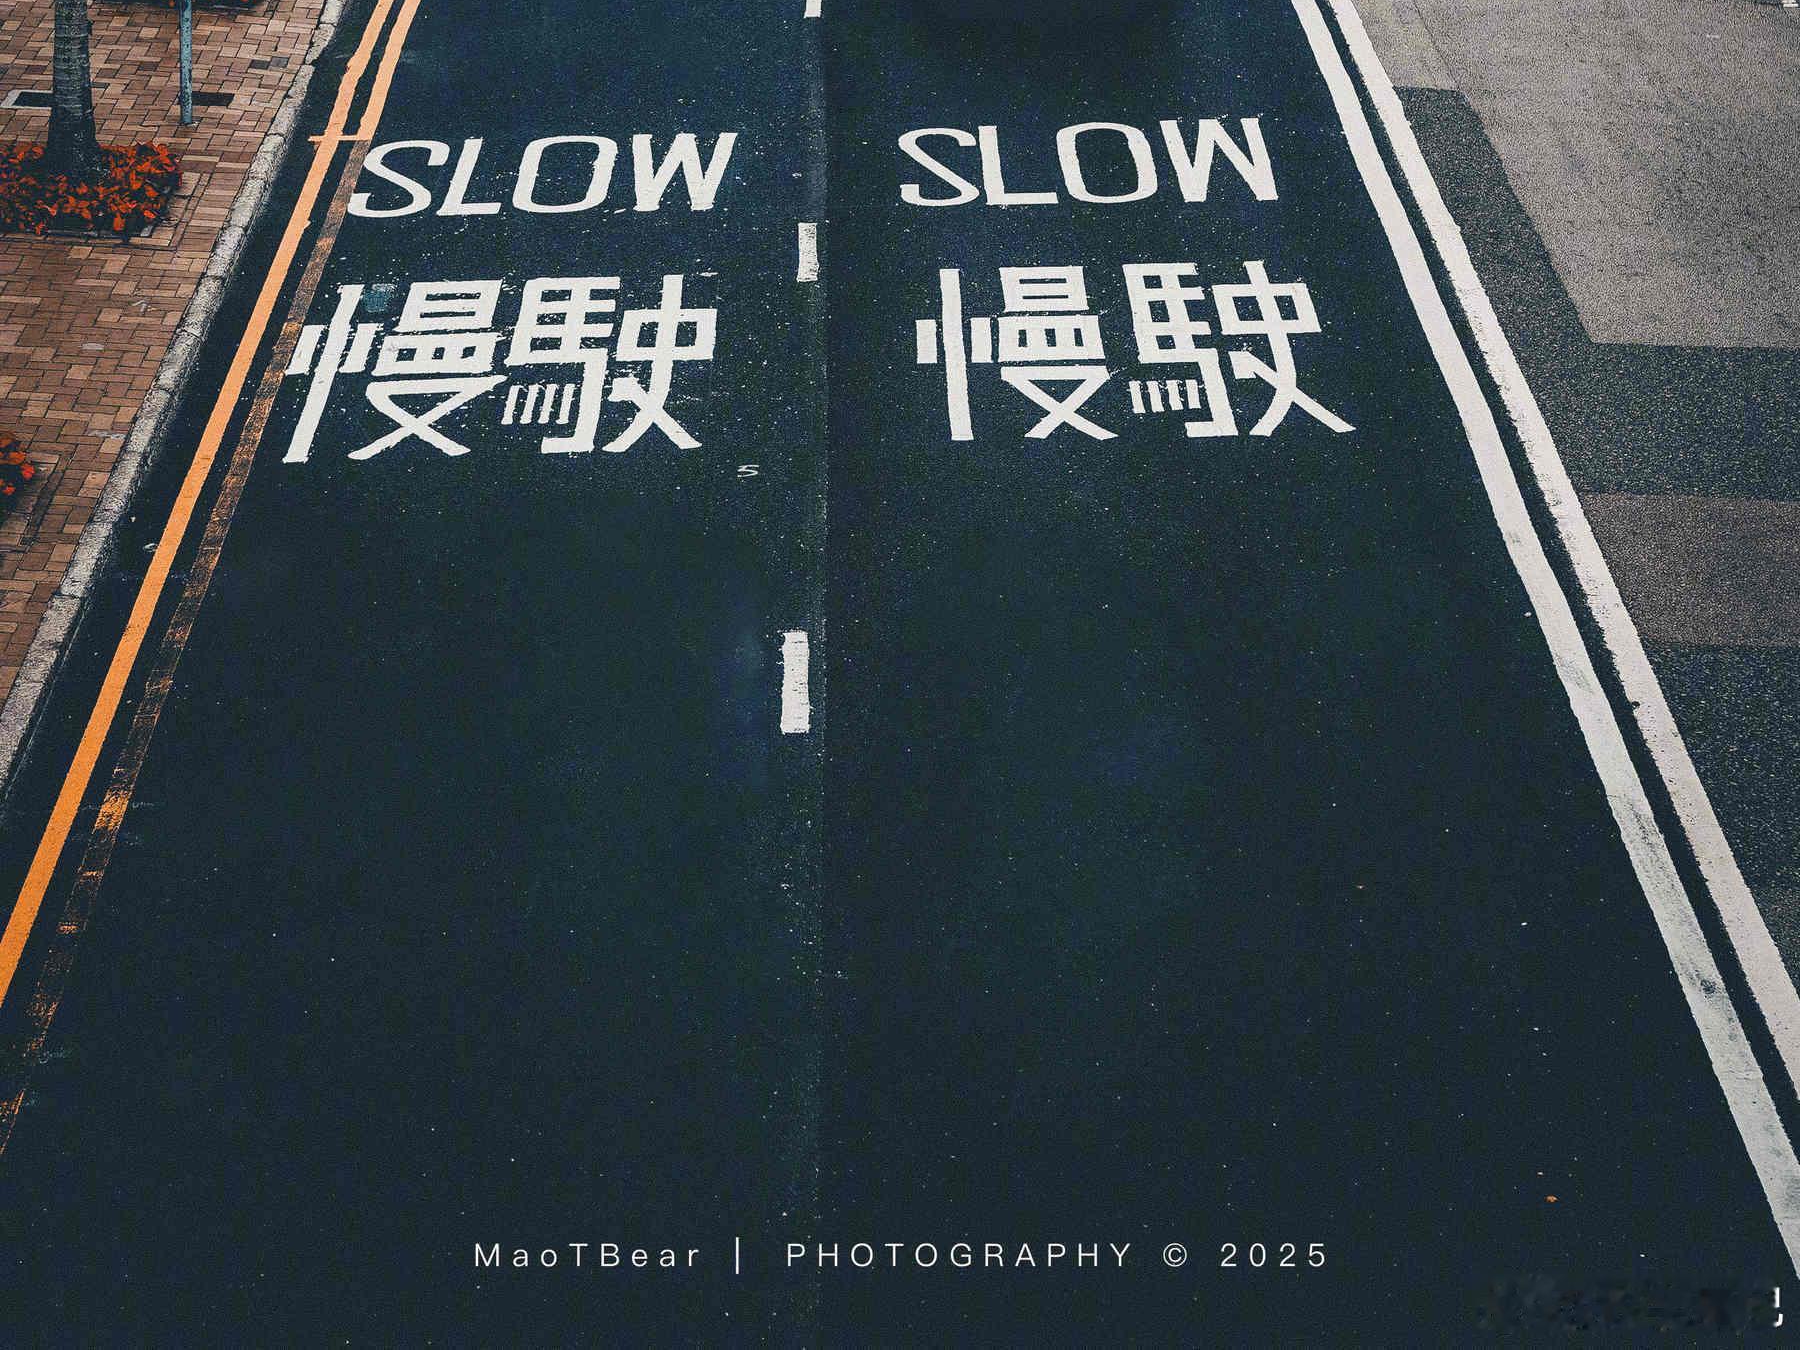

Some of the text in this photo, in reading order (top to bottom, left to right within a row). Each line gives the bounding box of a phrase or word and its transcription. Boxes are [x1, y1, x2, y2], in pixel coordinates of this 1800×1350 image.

[347, 133, 738, 217] SLOW
[898, 118, 1278, 206] SLOW
[281, 274, 718, 463] 慢駛
[915, 260, 1357, 441] 慢駛
